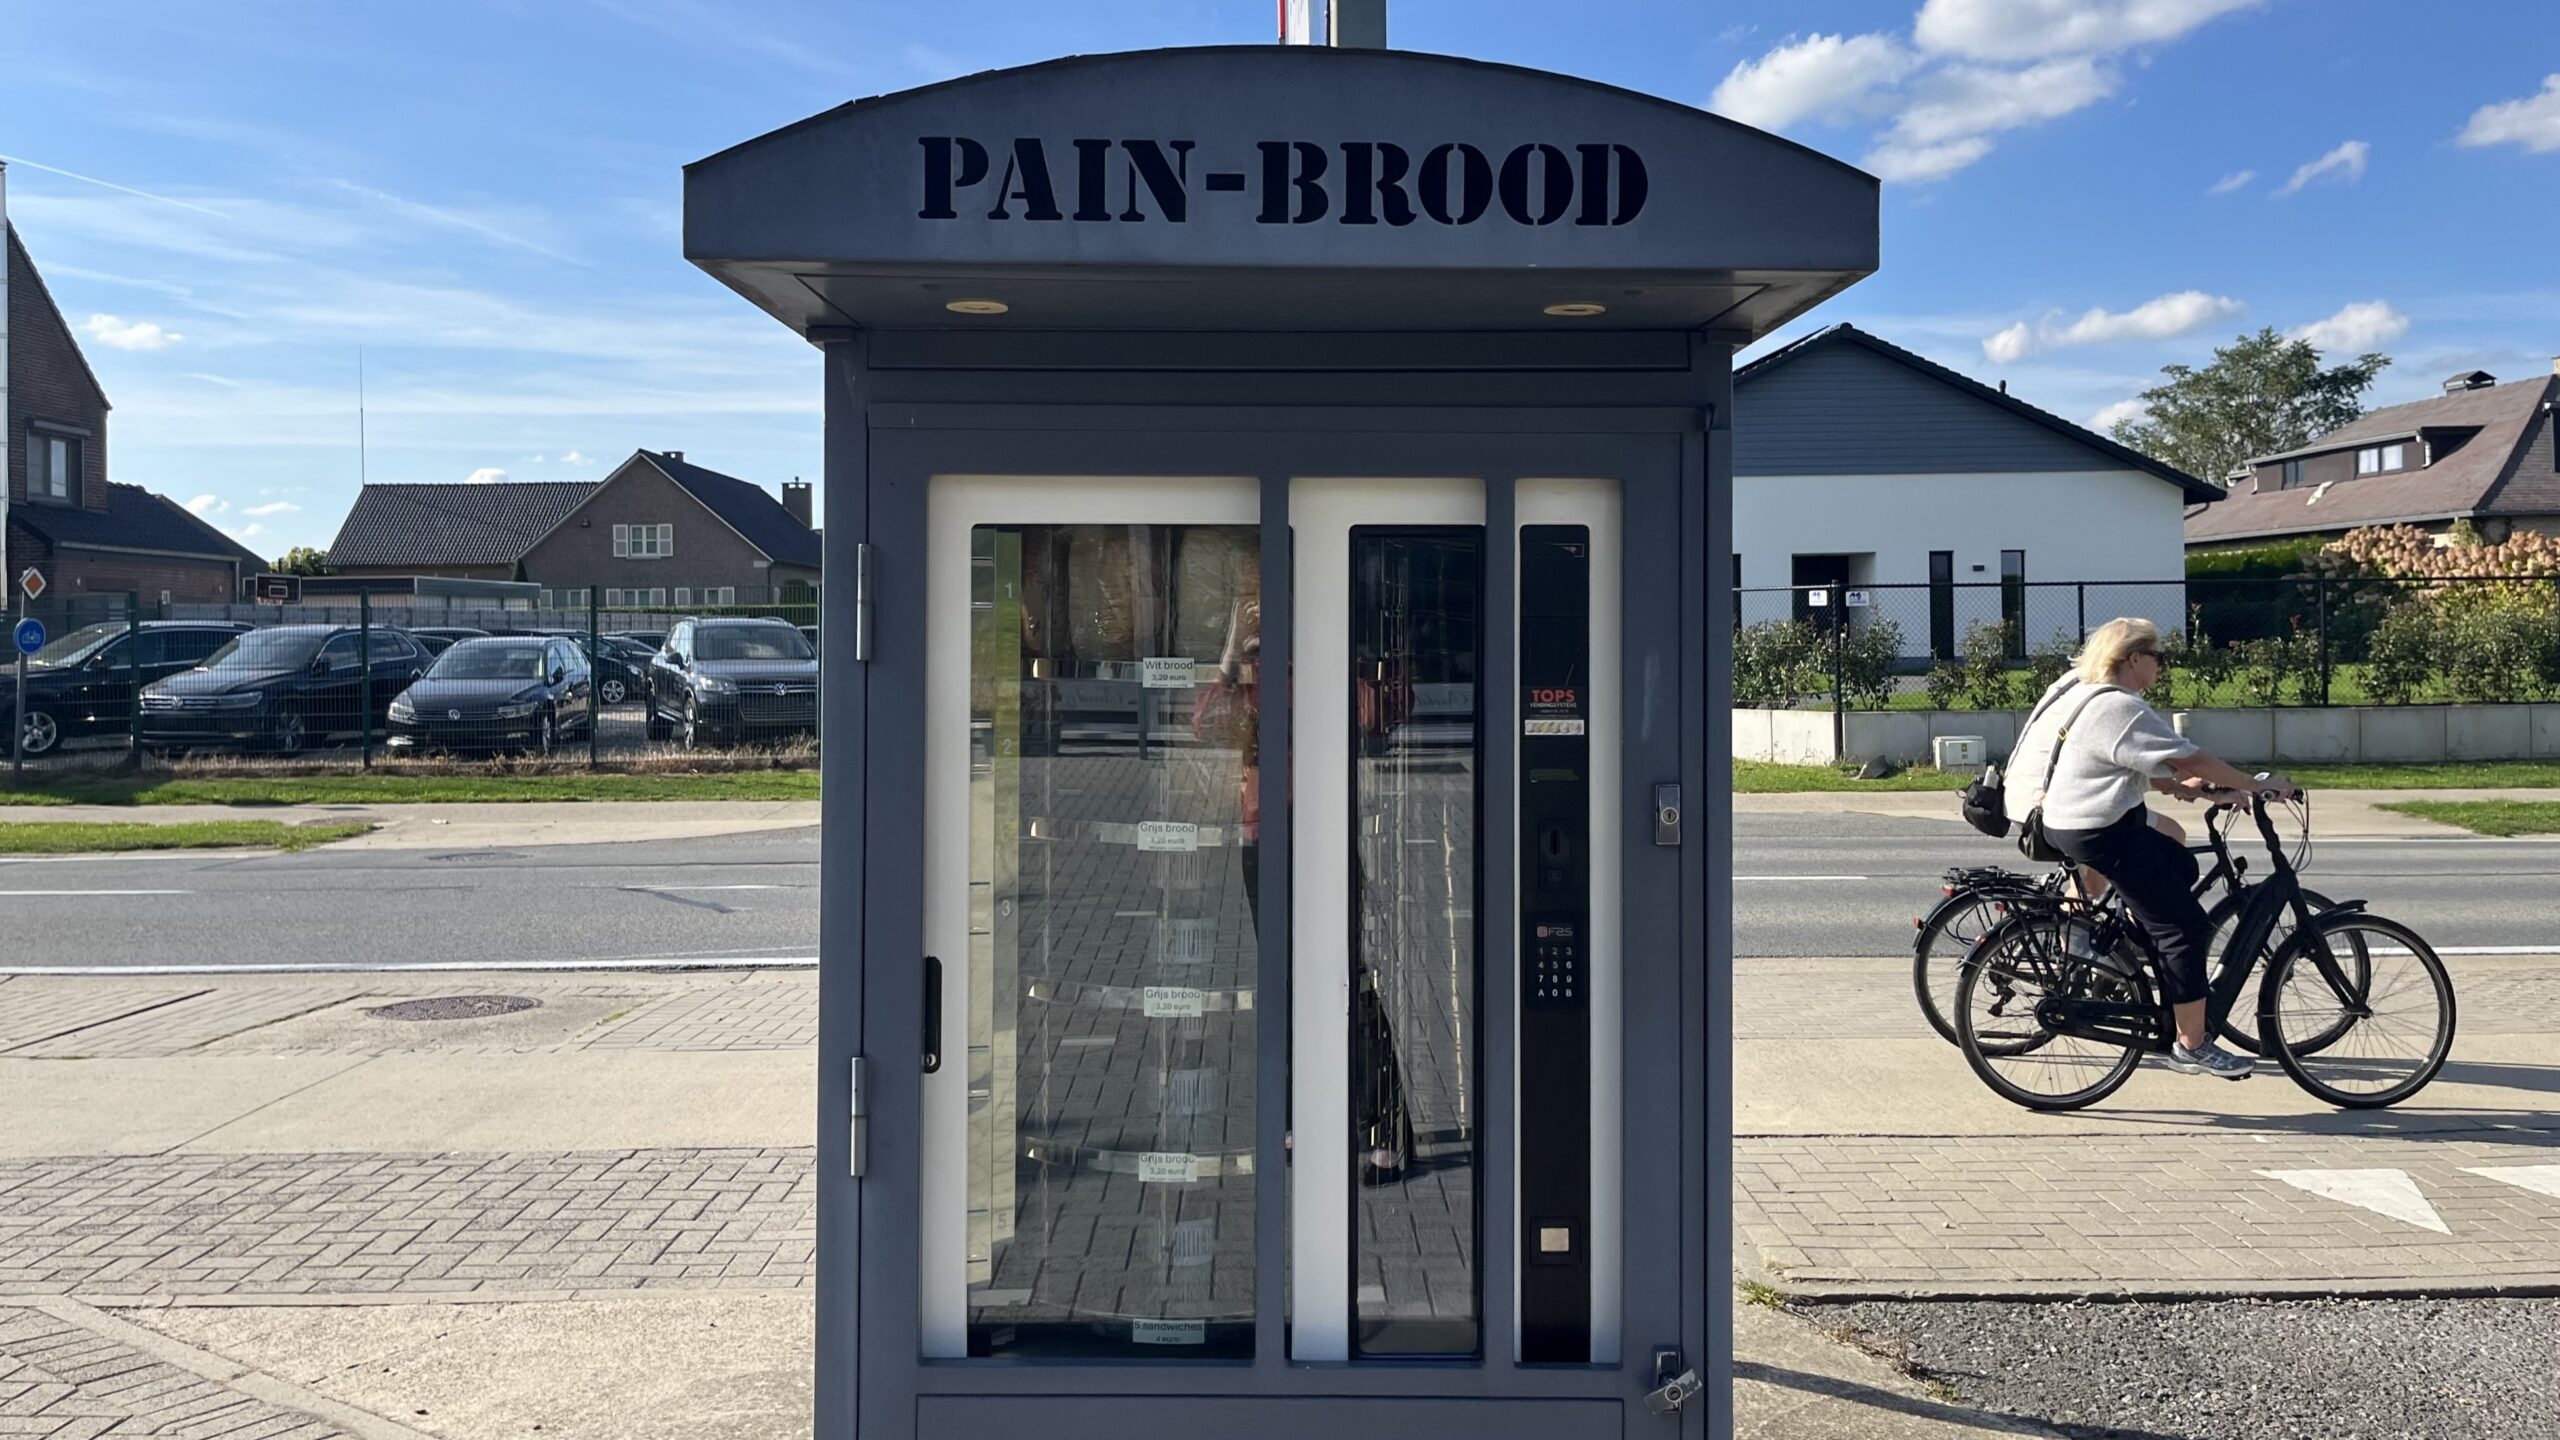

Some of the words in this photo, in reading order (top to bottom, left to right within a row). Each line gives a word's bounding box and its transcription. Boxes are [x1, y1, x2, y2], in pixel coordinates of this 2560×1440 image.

[917, 135, 1649, 227] PAIN-BROOD
[1004, 582, 1012, 598] 1
[1145, 660, 1161, 670] Wit
[1164, 660, 1193, 670] brood
[1532, 689, 1575, 702] TOPS
[1003, 738, 1012, 755] 2
[1140, 822, 1163, 834] Grijs
[1165, 824, 1195, 833] brood
[1002, 899, 1011, 917] 3
[1145, 988, 1169, 1000] Grijs
[1140, 1153, 1163, 1165] Grijs
[998, 1212, 1007, 1229] 5
